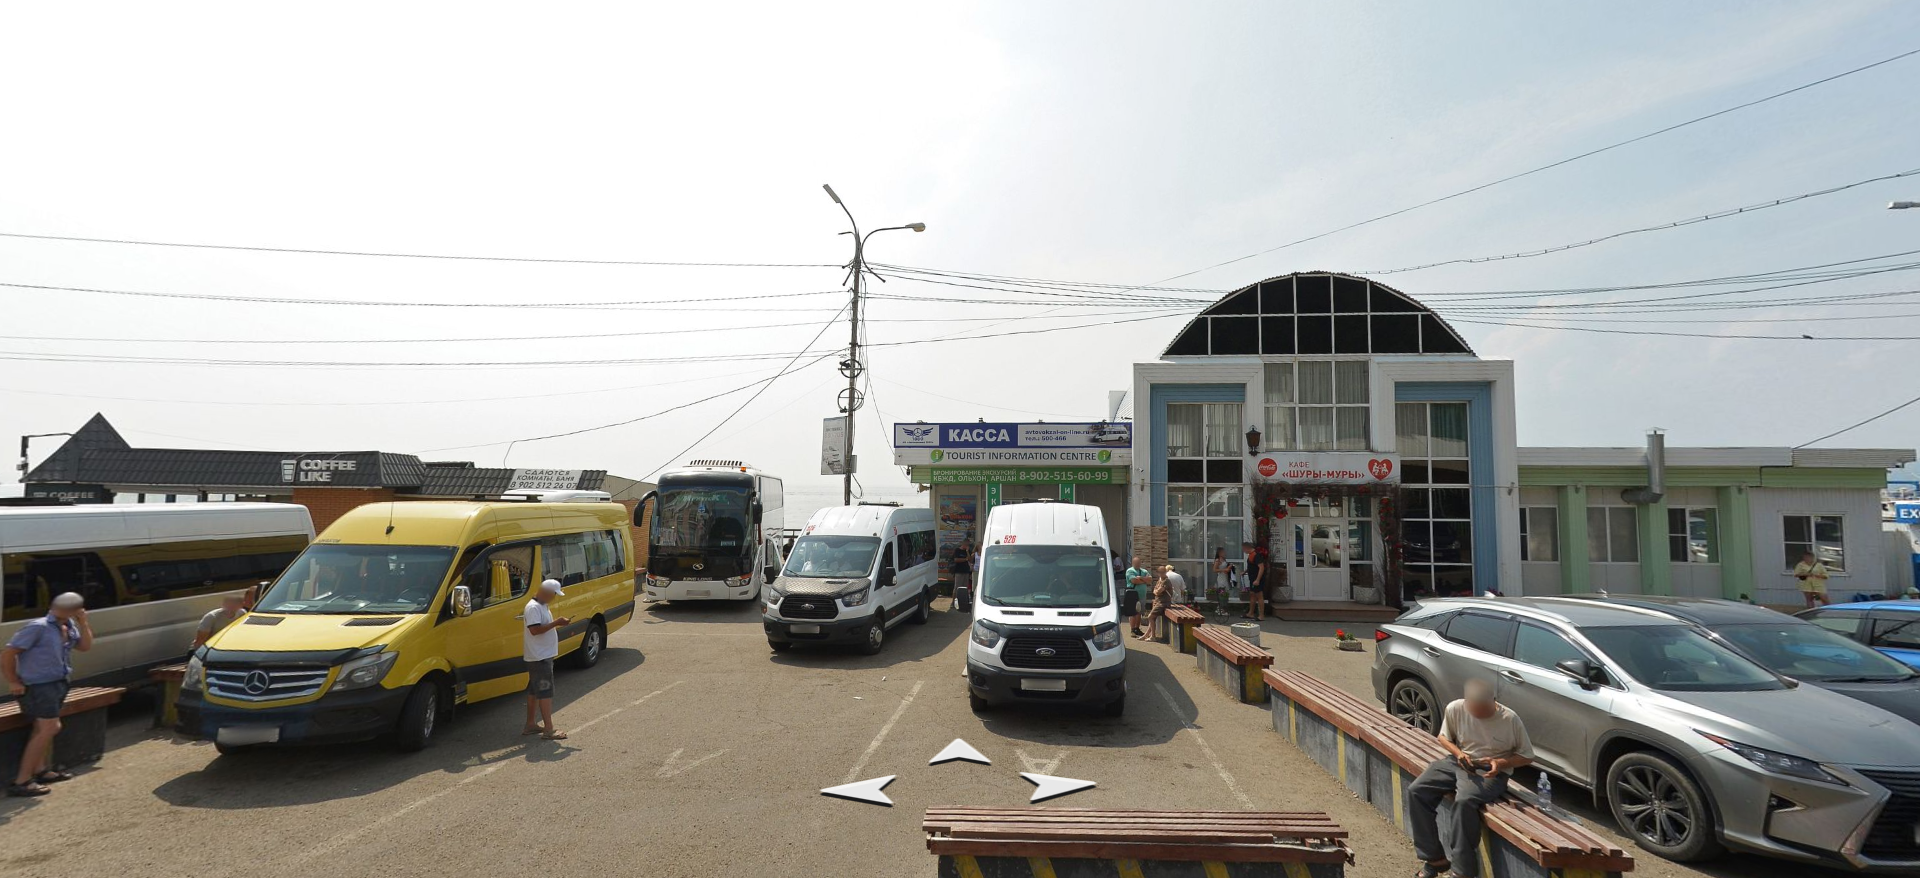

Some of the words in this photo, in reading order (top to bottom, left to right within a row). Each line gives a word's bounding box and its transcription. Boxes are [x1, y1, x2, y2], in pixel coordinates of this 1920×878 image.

[948, 429, 1010, 442] КАССА
[946, 452, 986, 460] TOURIST
[989, 452, 1057, 460] INFORMATION
[1060, 452, 1096, 461] CENTRE
[300, 460, 356, 470] COFFEE
[300, 471, 332, 482] LIKE
[1019, 471, 1109, 481] 8-902-515-60-99
[1282, 470, 1365, 479] «ШУРЫ-МУРЫ»
[49, 491, 95, 499] COFFEE
[1899, 508, 1920, 519] EX
[1003, 534, 1017, 543] 526
